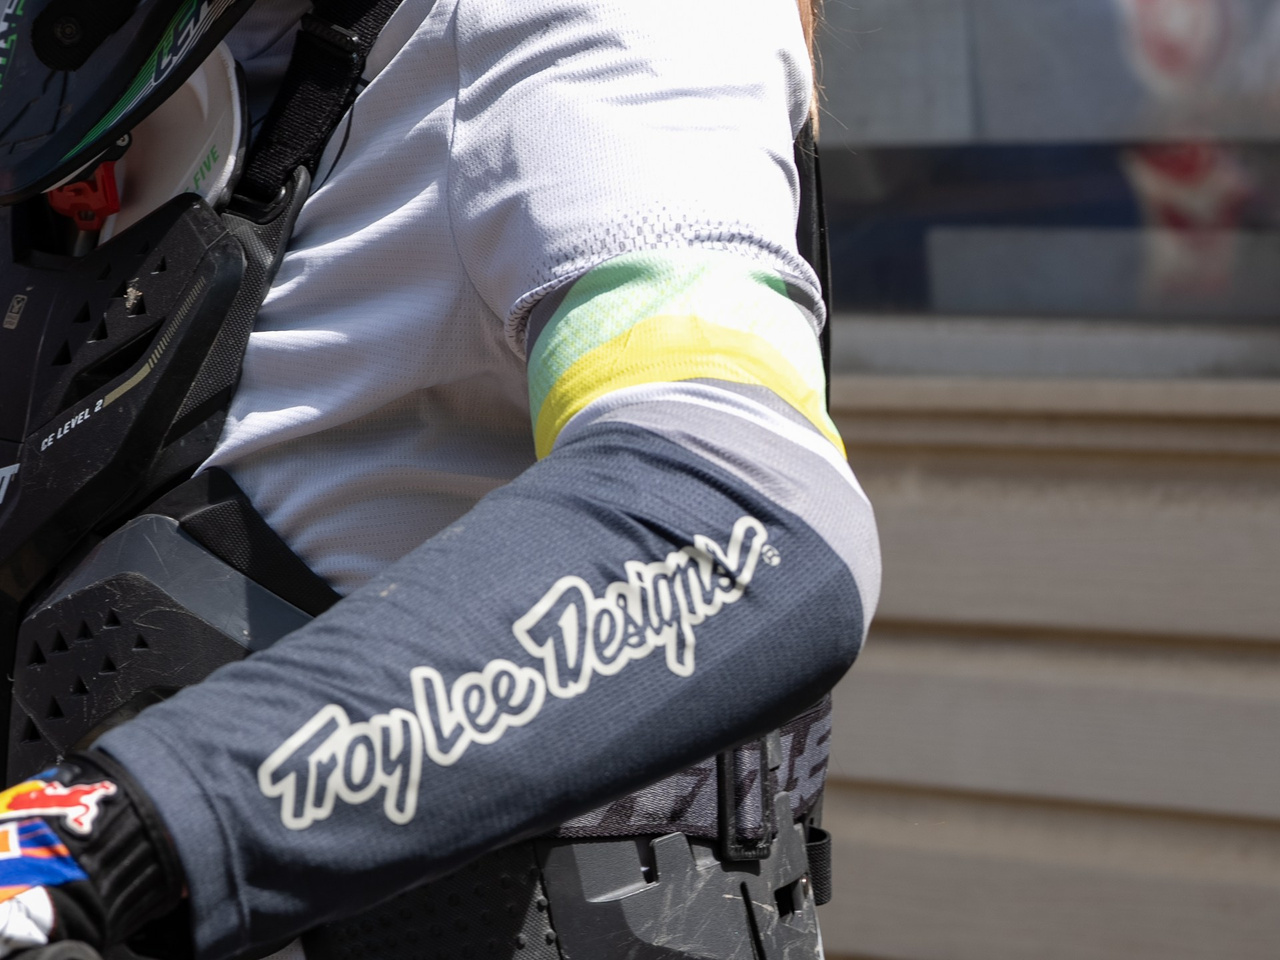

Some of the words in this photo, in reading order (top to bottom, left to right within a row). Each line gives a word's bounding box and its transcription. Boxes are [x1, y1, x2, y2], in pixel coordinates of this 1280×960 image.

[193, 143, 220, 191] FIVE
[41, 432, 55, 452] CE
[56, 408, 91, 439] LEVEL
[94, 399, 104, 413] 2
[258, 704, 423, 830] Troy
[410, 658, 547, 766] Lee
[512, 515, 769, 699] Designs
